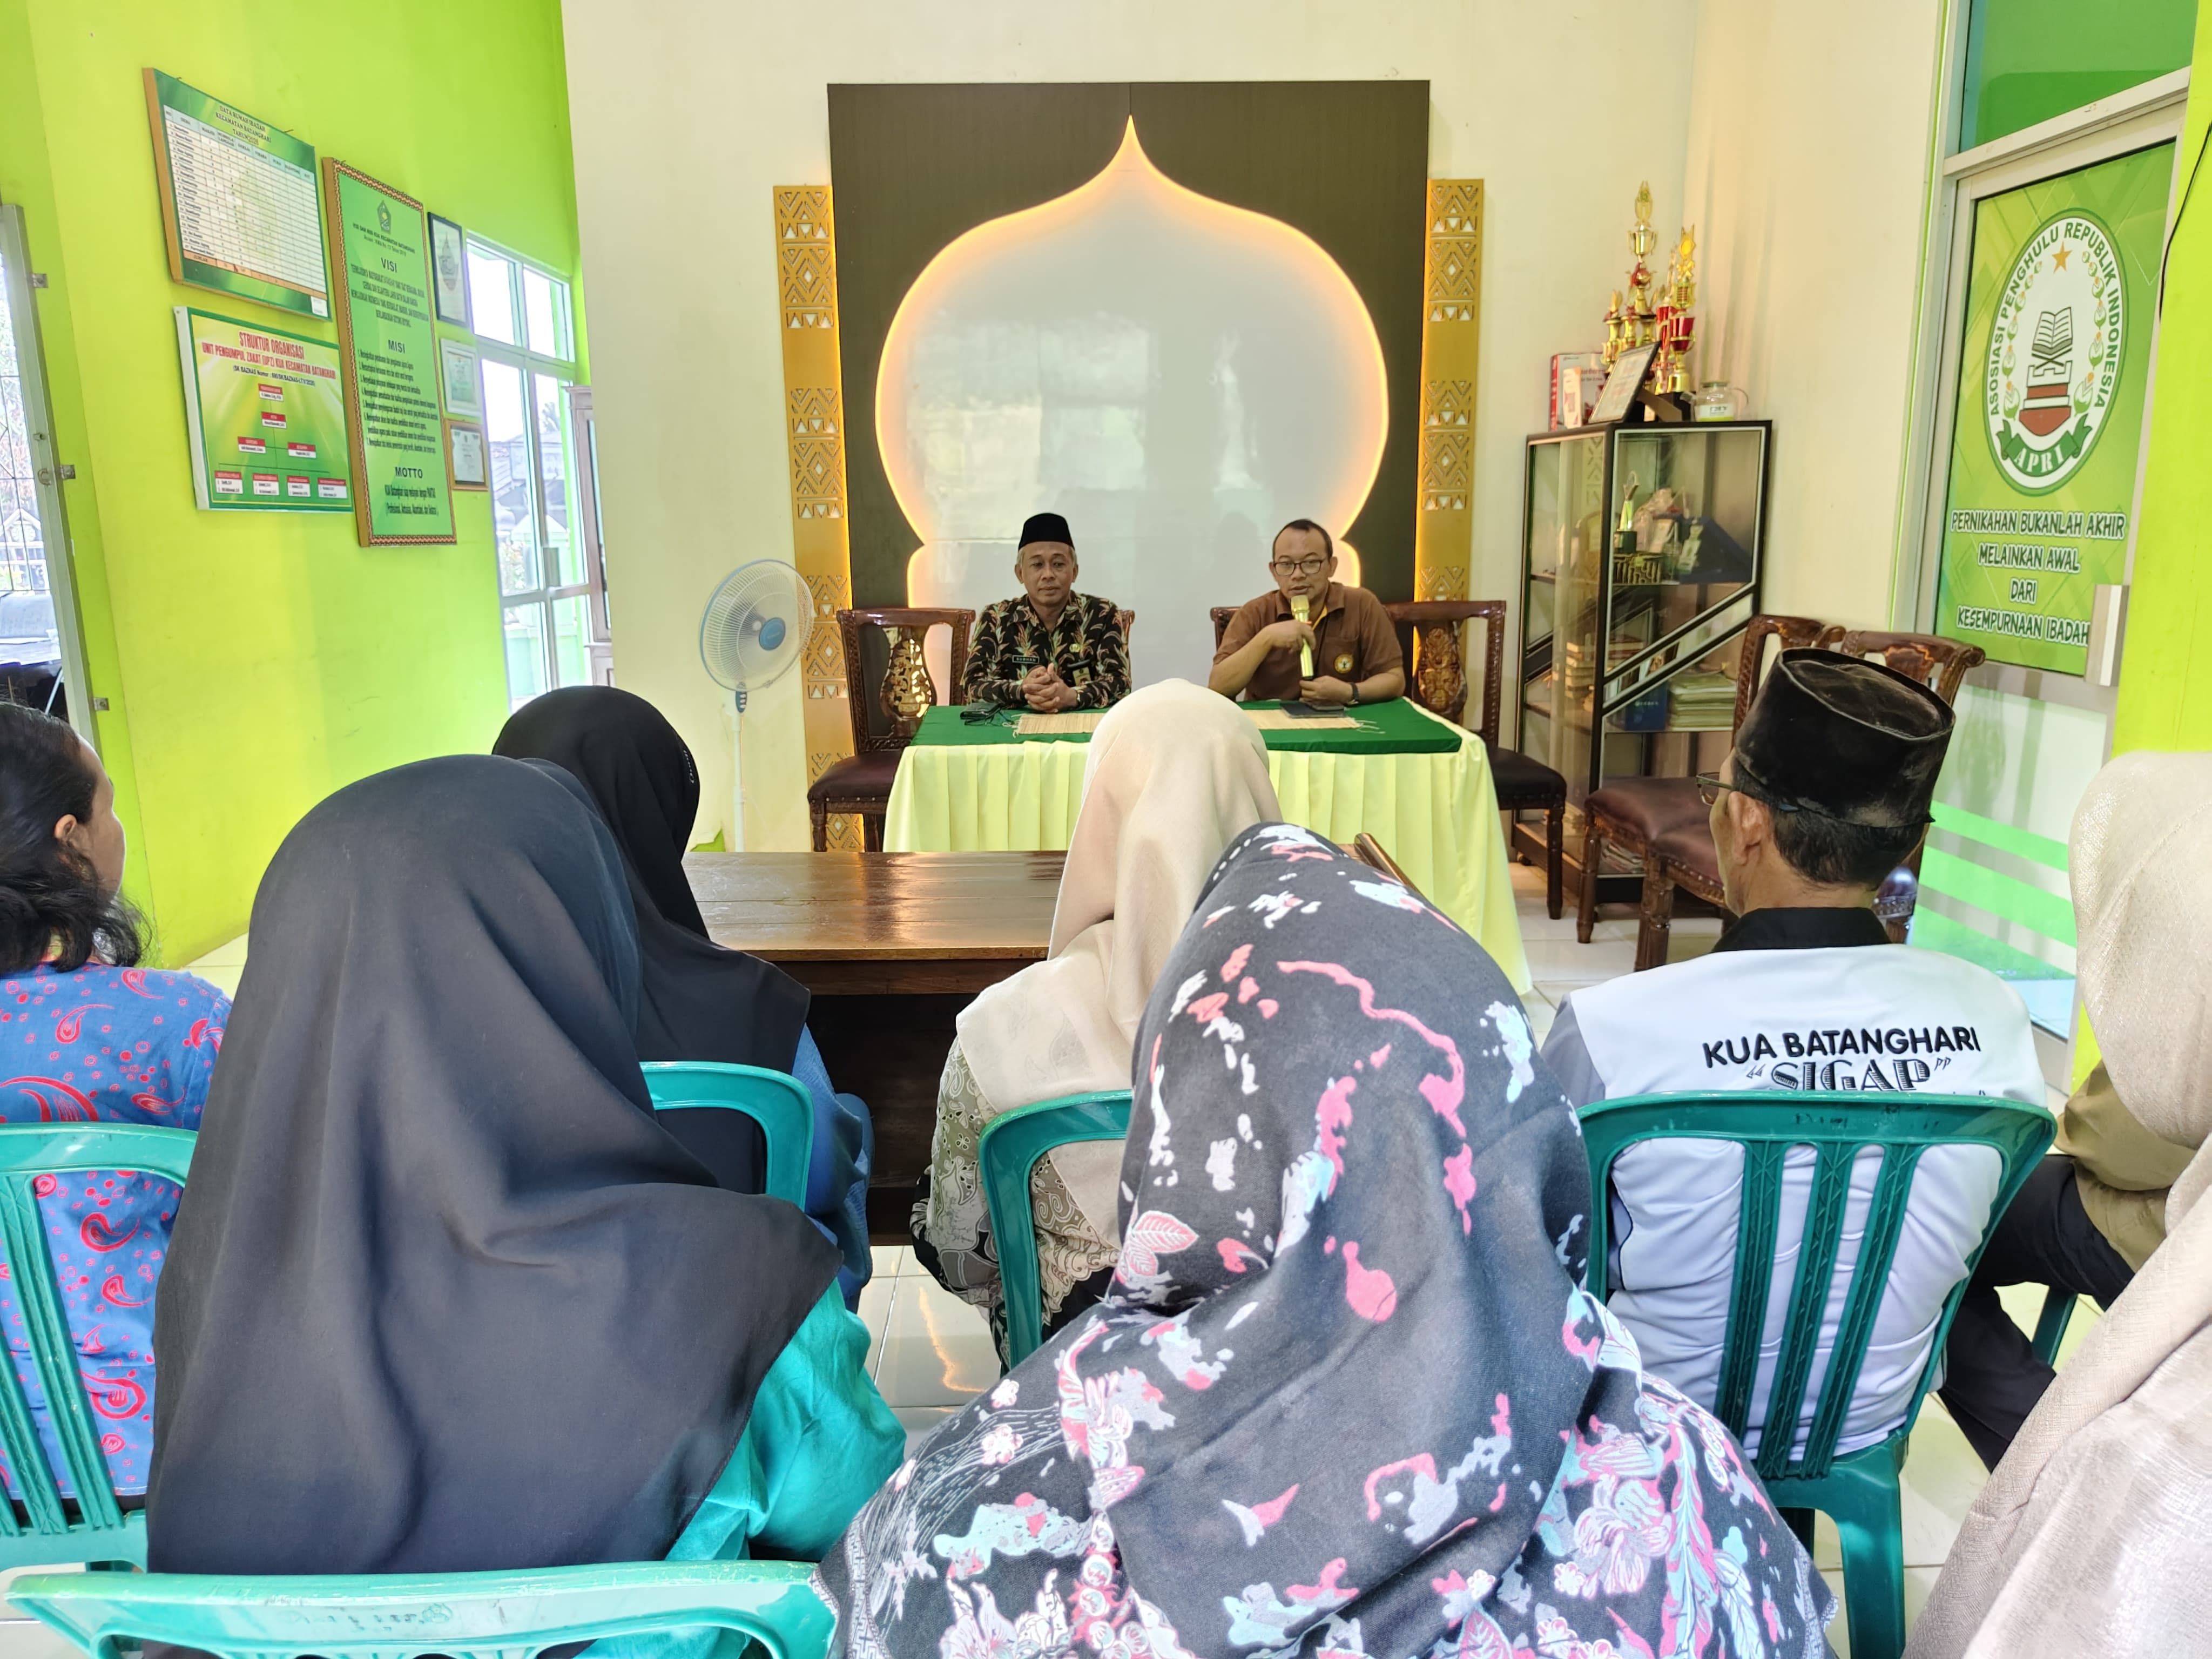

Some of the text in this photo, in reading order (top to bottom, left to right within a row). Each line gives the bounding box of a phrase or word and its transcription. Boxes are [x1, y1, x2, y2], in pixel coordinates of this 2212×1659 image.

[381, 257, 397, 273] VISI
[1989, 222, 2120, 415] ASOSIASI PENGHULU REPUBLIK INDONESIA
[239, 332, 305, 360] STRUKTUR ORGANISASI
[388, 340, 406, 354] MISI
[2014, 444, 2064, 472] APRI
[395, 467, 423, 478] MOTTO
[1951, 511, 2126, 538] PERNIKAHAN BUKANLAH AKHIR
[1979, 543, 2080, 572] MELAINKAN AWAL
[2010, 579, 2036, 603] DARI
[1957, 606, 2090, 645] KESEMPURNAAN IBADAH
[1702, 1026, 1981, 1068] KUA BATANGHARI
